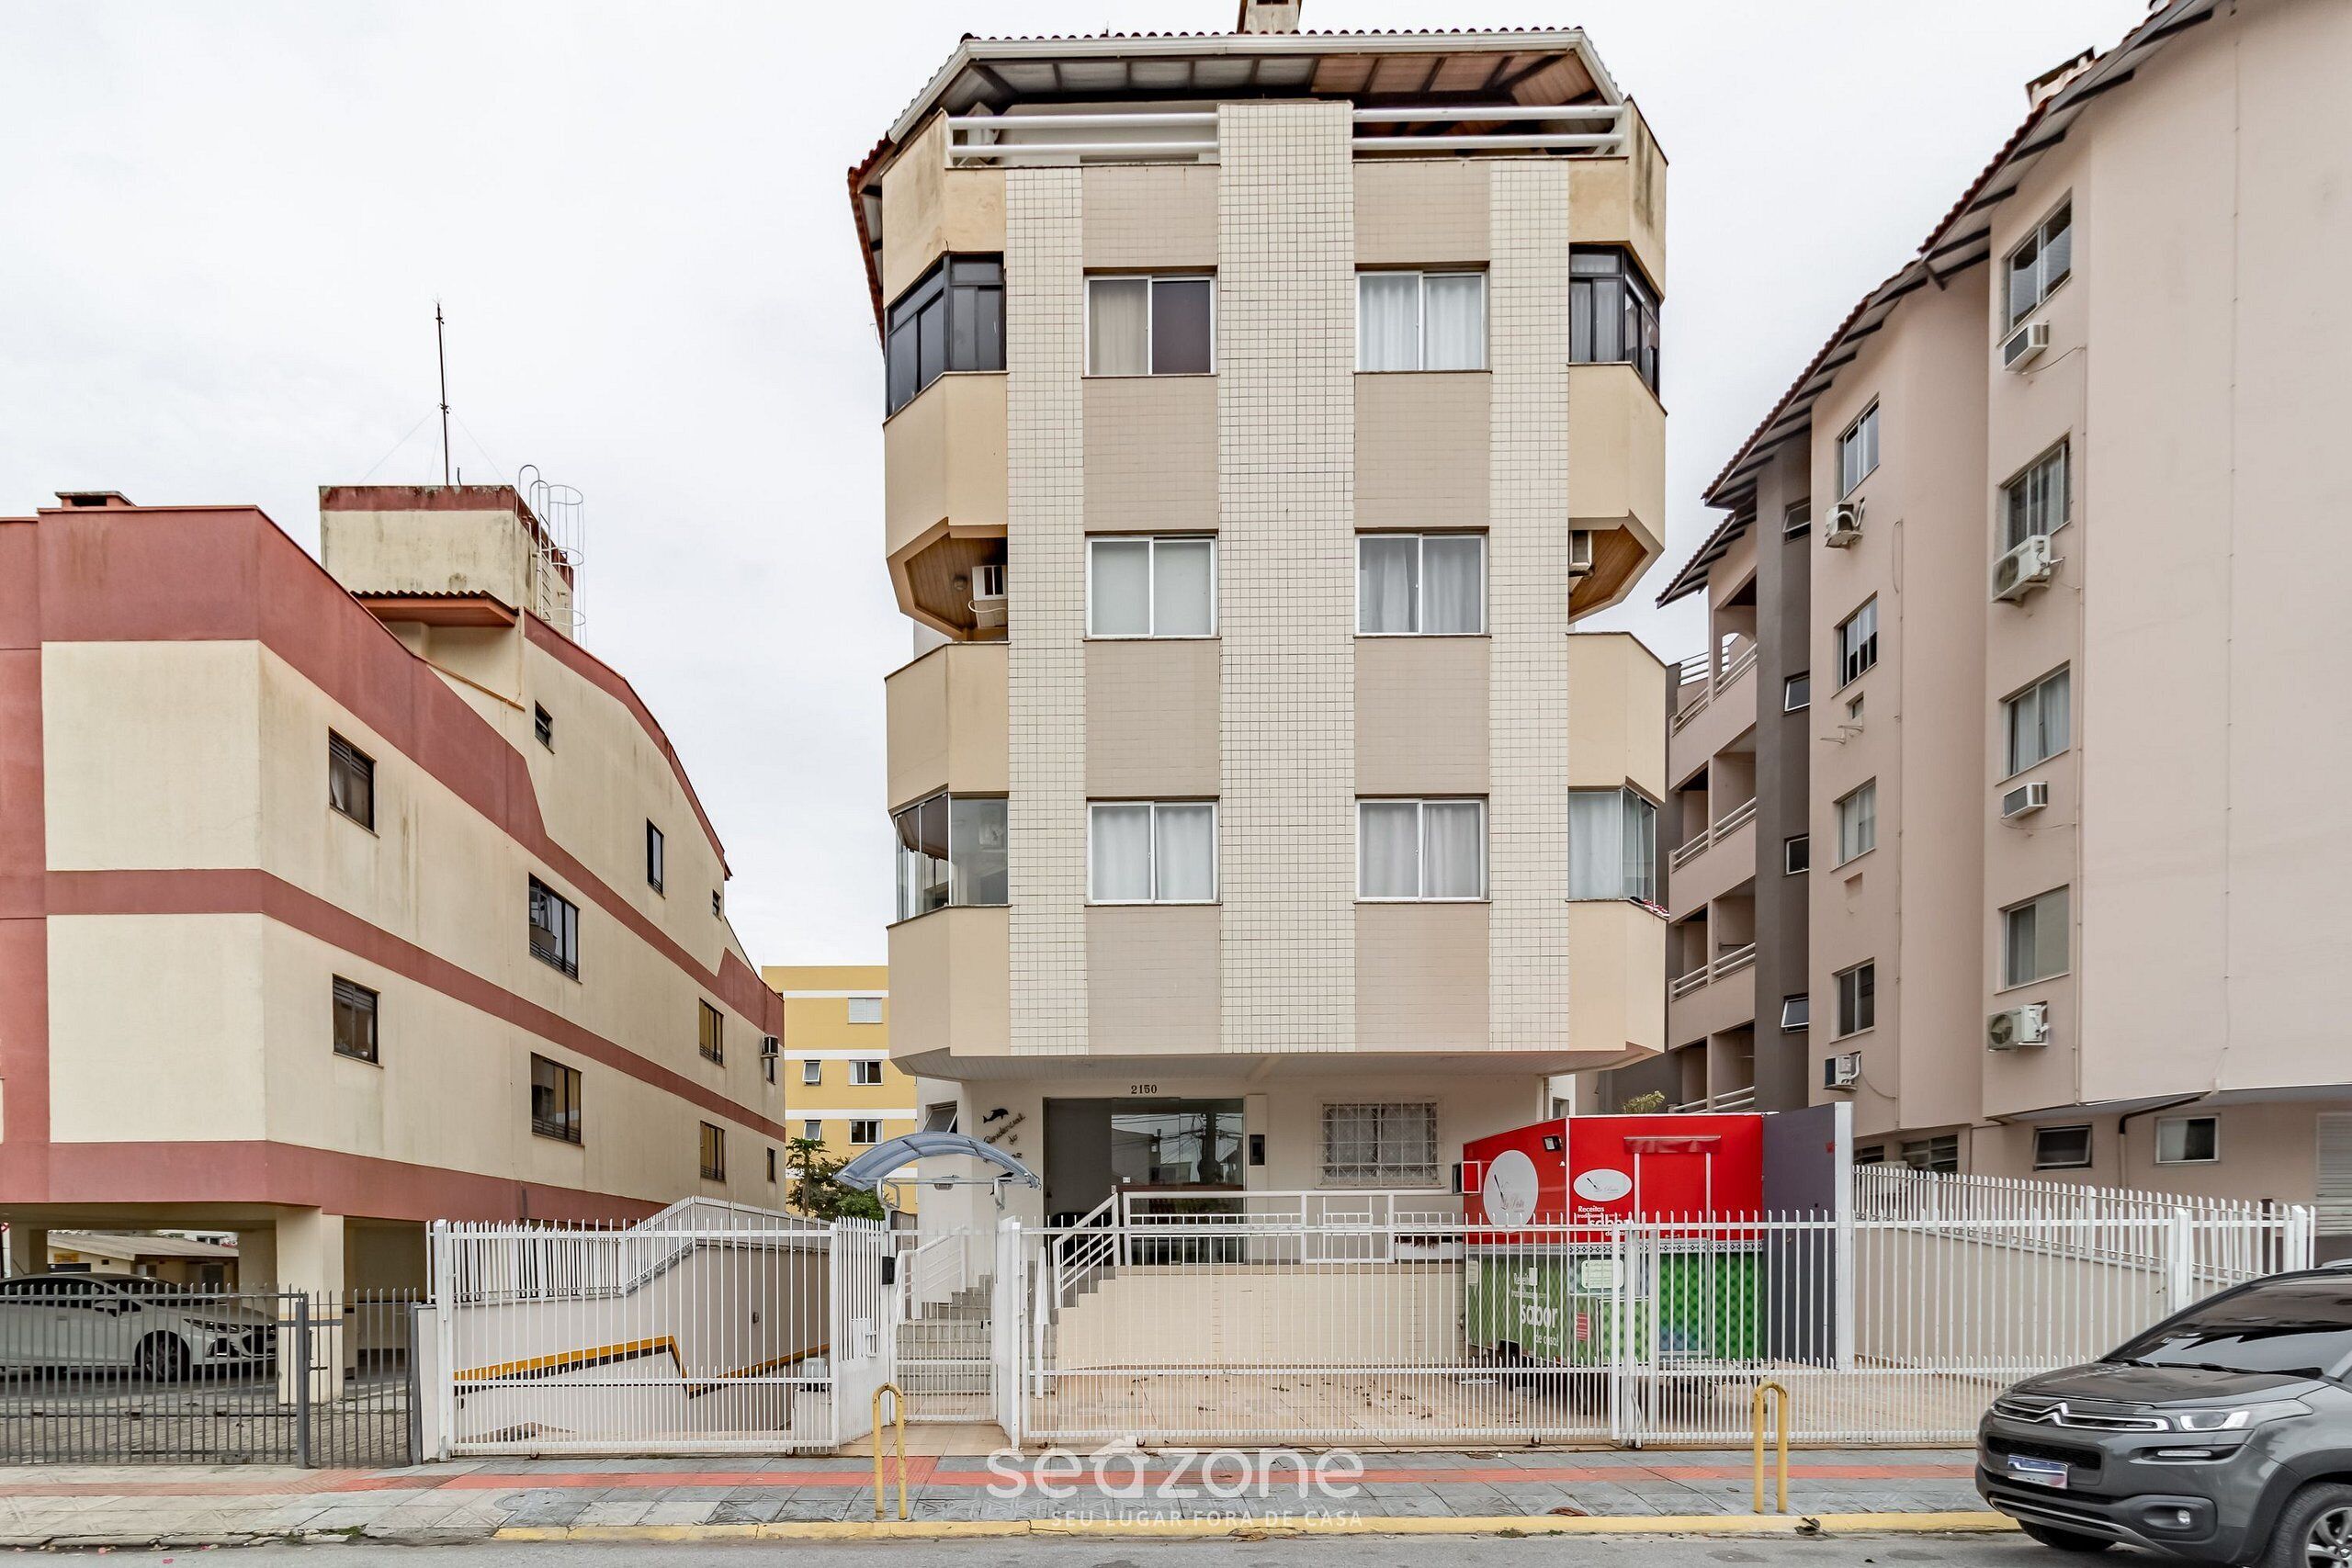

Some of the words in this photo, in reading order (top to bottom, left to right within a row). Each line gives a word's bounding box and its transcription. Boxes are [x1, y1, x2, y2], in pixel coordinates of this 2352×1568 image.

[1131, 1084, 1158, 1094] 2150
[1521, 1298, 1558, 1328] sabor
[1544, 1333, 1559, 1347] csa!
